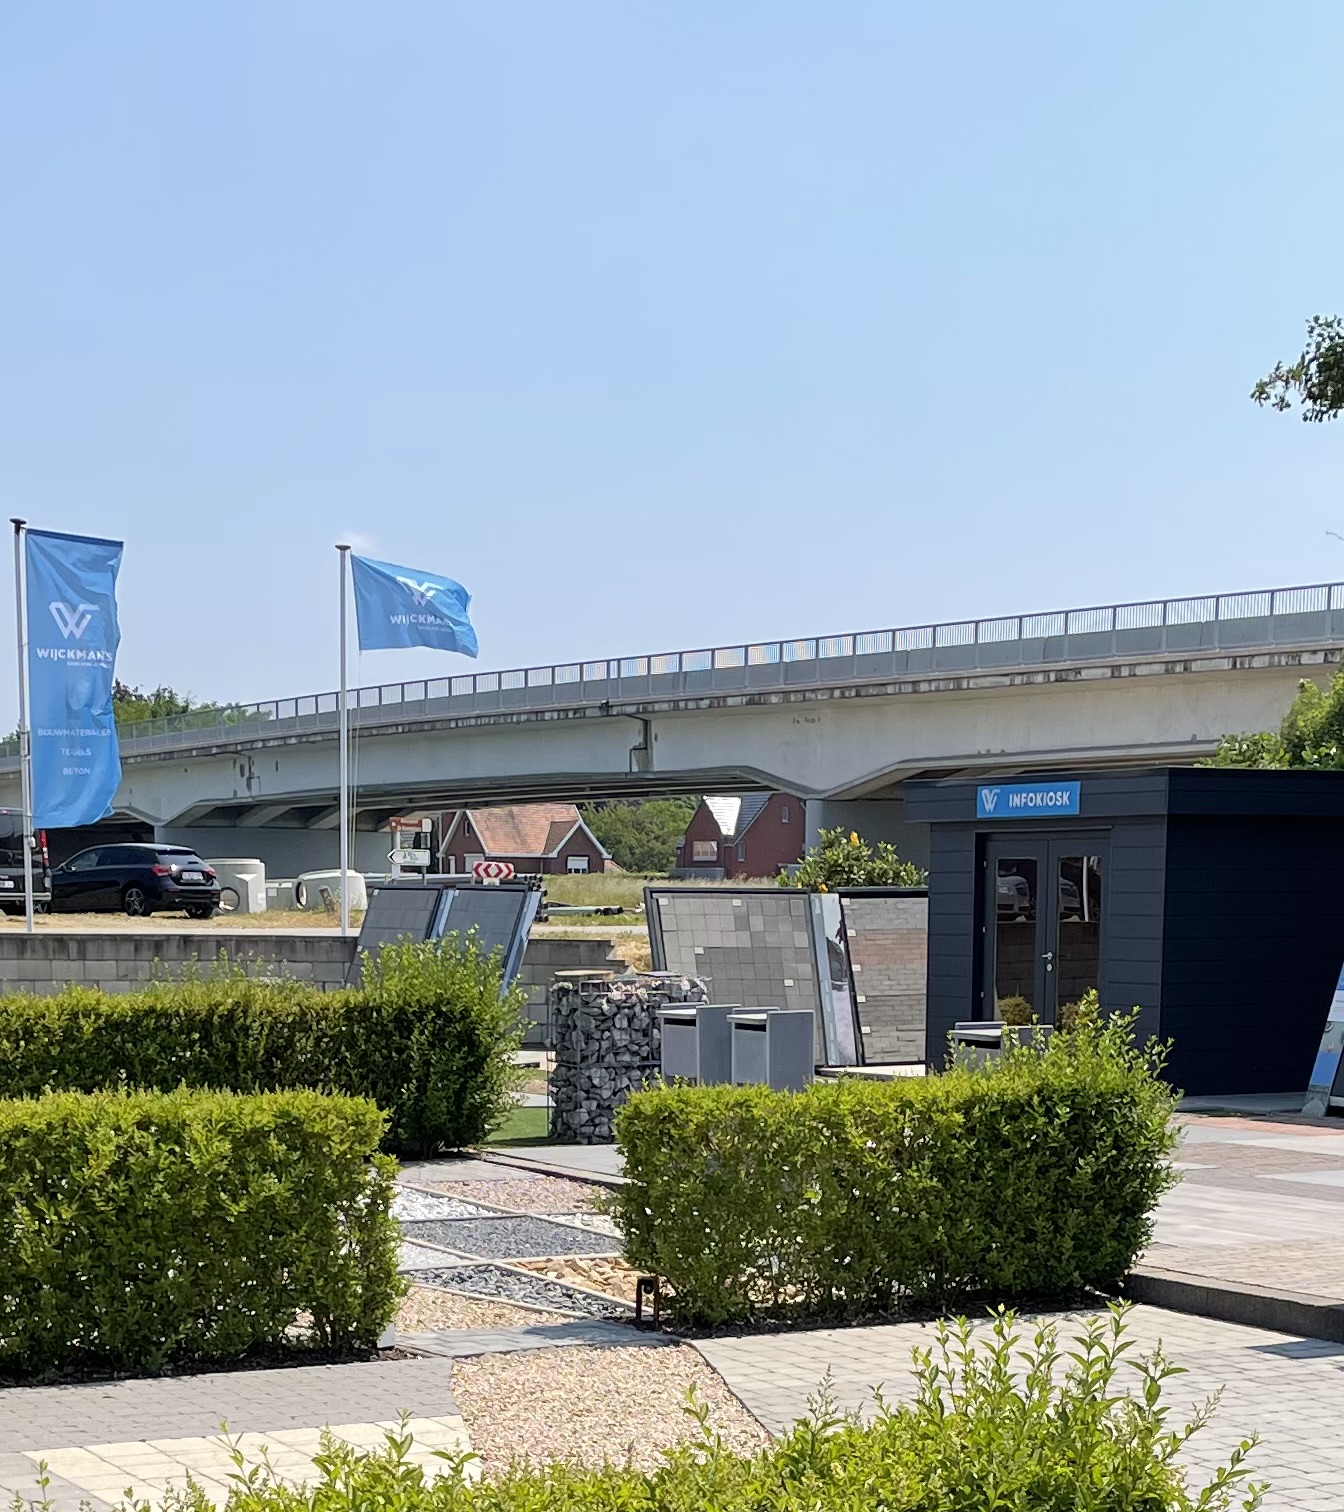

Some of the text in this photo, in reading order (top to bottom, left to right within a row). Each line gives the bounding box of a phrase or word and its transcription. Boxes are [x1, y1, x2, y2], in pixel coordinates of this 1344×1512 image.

[36, 647, 113, 662] WIJCKMANS
[62, 767, 91, 776] BETON
[1008, 790, 1071, 808] INFOKIOSK
